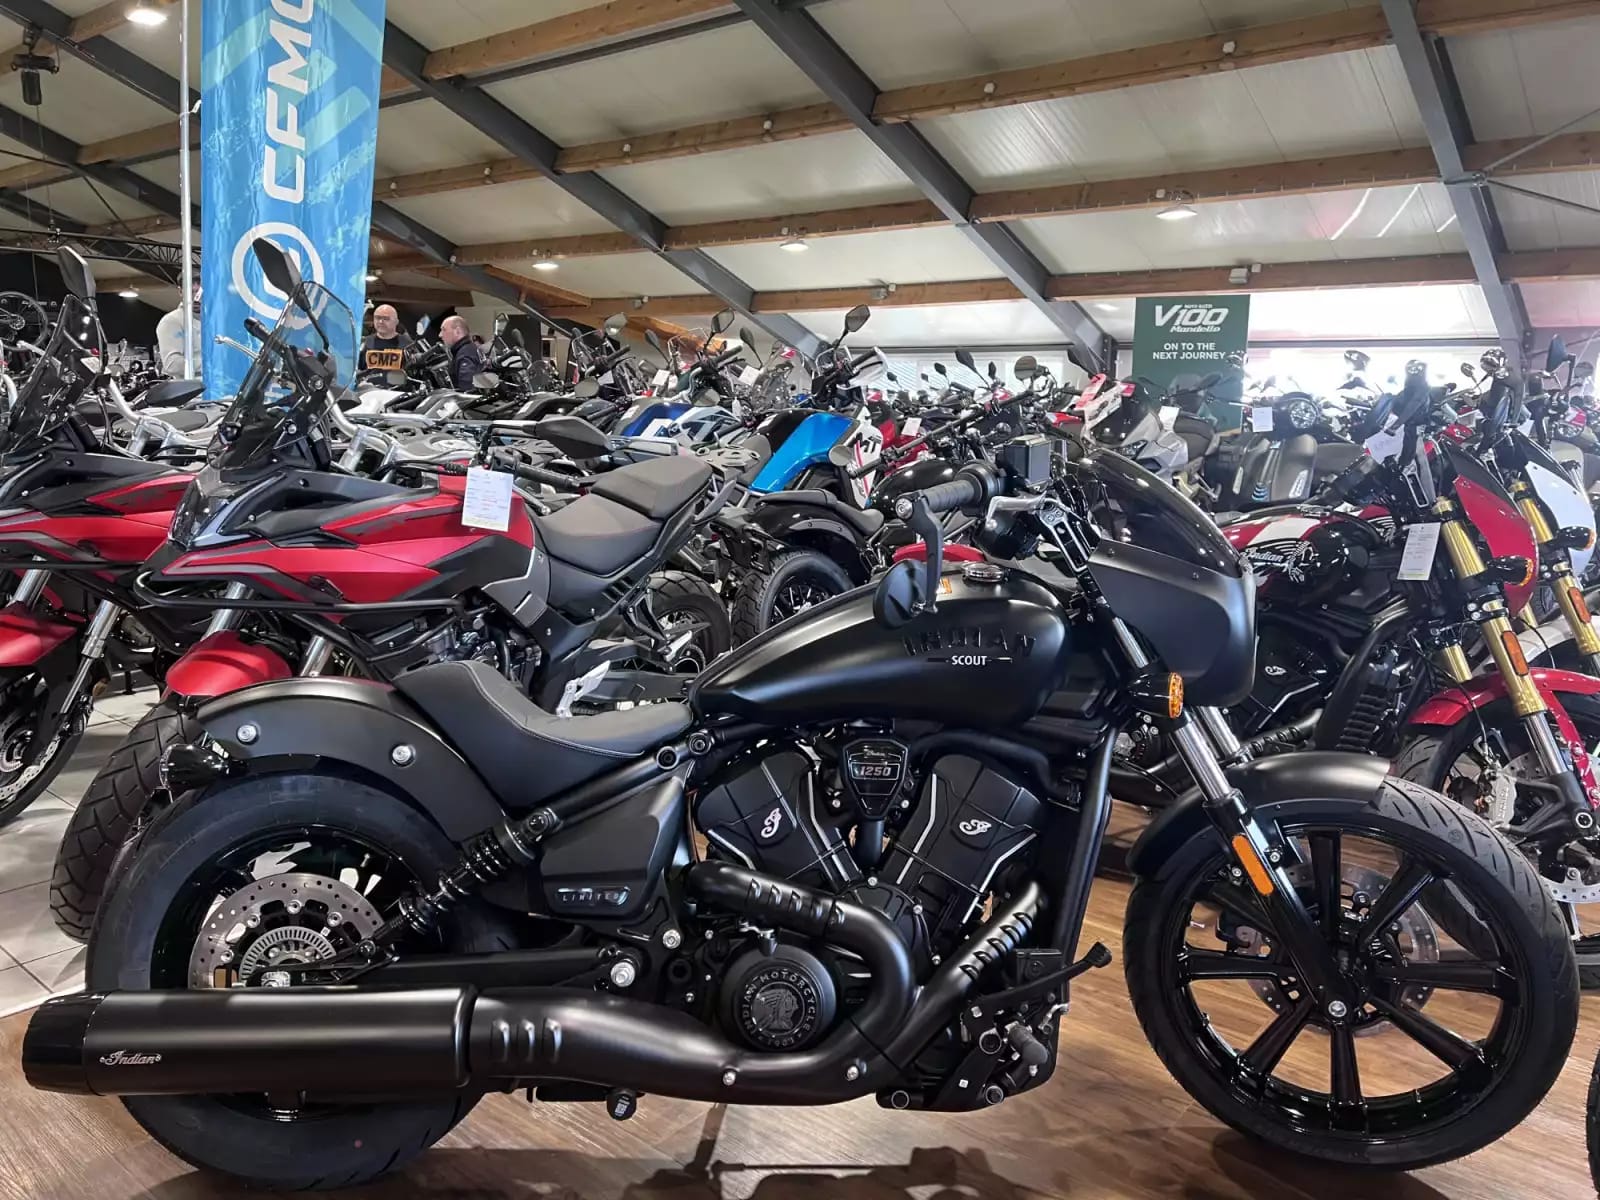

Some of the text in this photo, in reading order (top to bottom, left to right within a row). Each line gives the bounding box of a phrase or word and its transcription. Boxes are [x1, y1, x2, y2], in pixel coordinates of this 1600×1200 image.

[1155, 305, 1229, 326] V100
[1170, 325, 1221, 333] Mandello
[1163, 342, 1217, 351] ON TO THE
[368, 352, 400, 367] CMP
[1152, 351, 1226, 360] NEXT JOURNEY
[951, 655, 988, 666] SCOUT
[860, 765, 892, 777] 1250
[562, 892, 619, 902] LIMITED
[98, 1049, 162, 1066] Indian
